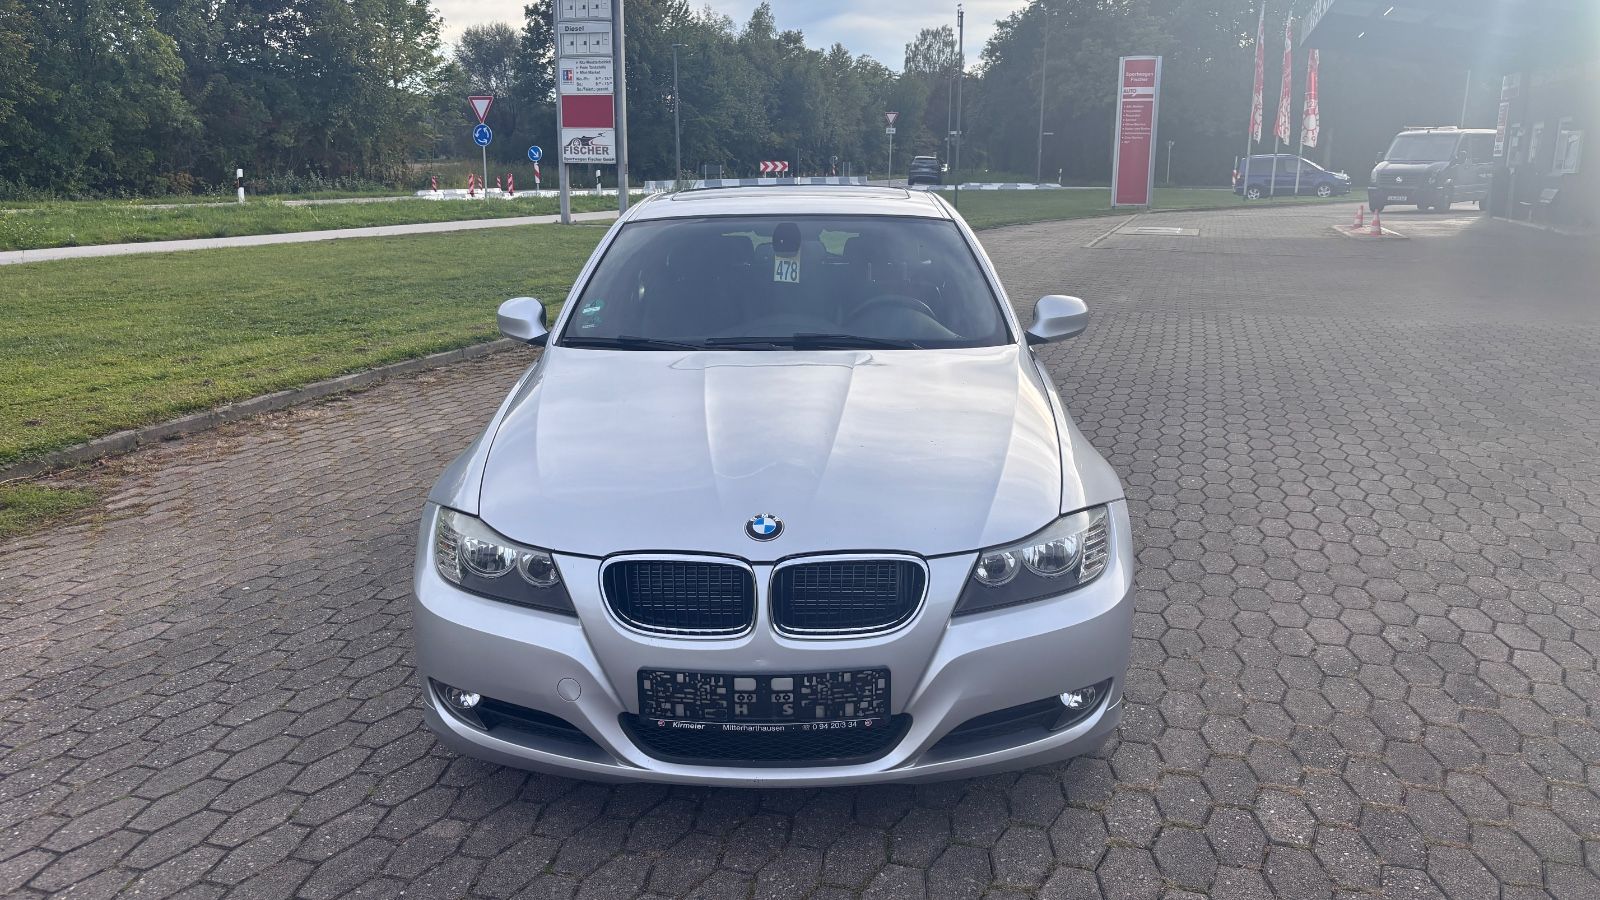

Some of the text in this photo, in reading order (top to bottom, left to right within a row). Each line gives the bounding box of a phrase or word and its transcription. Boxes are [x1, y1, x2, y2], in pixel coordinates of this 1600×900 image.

[563, 146, 609, 155] FISCHER
[775, 260, 798, 281] 478
[672, 721, 706, 730] Kirmeier
